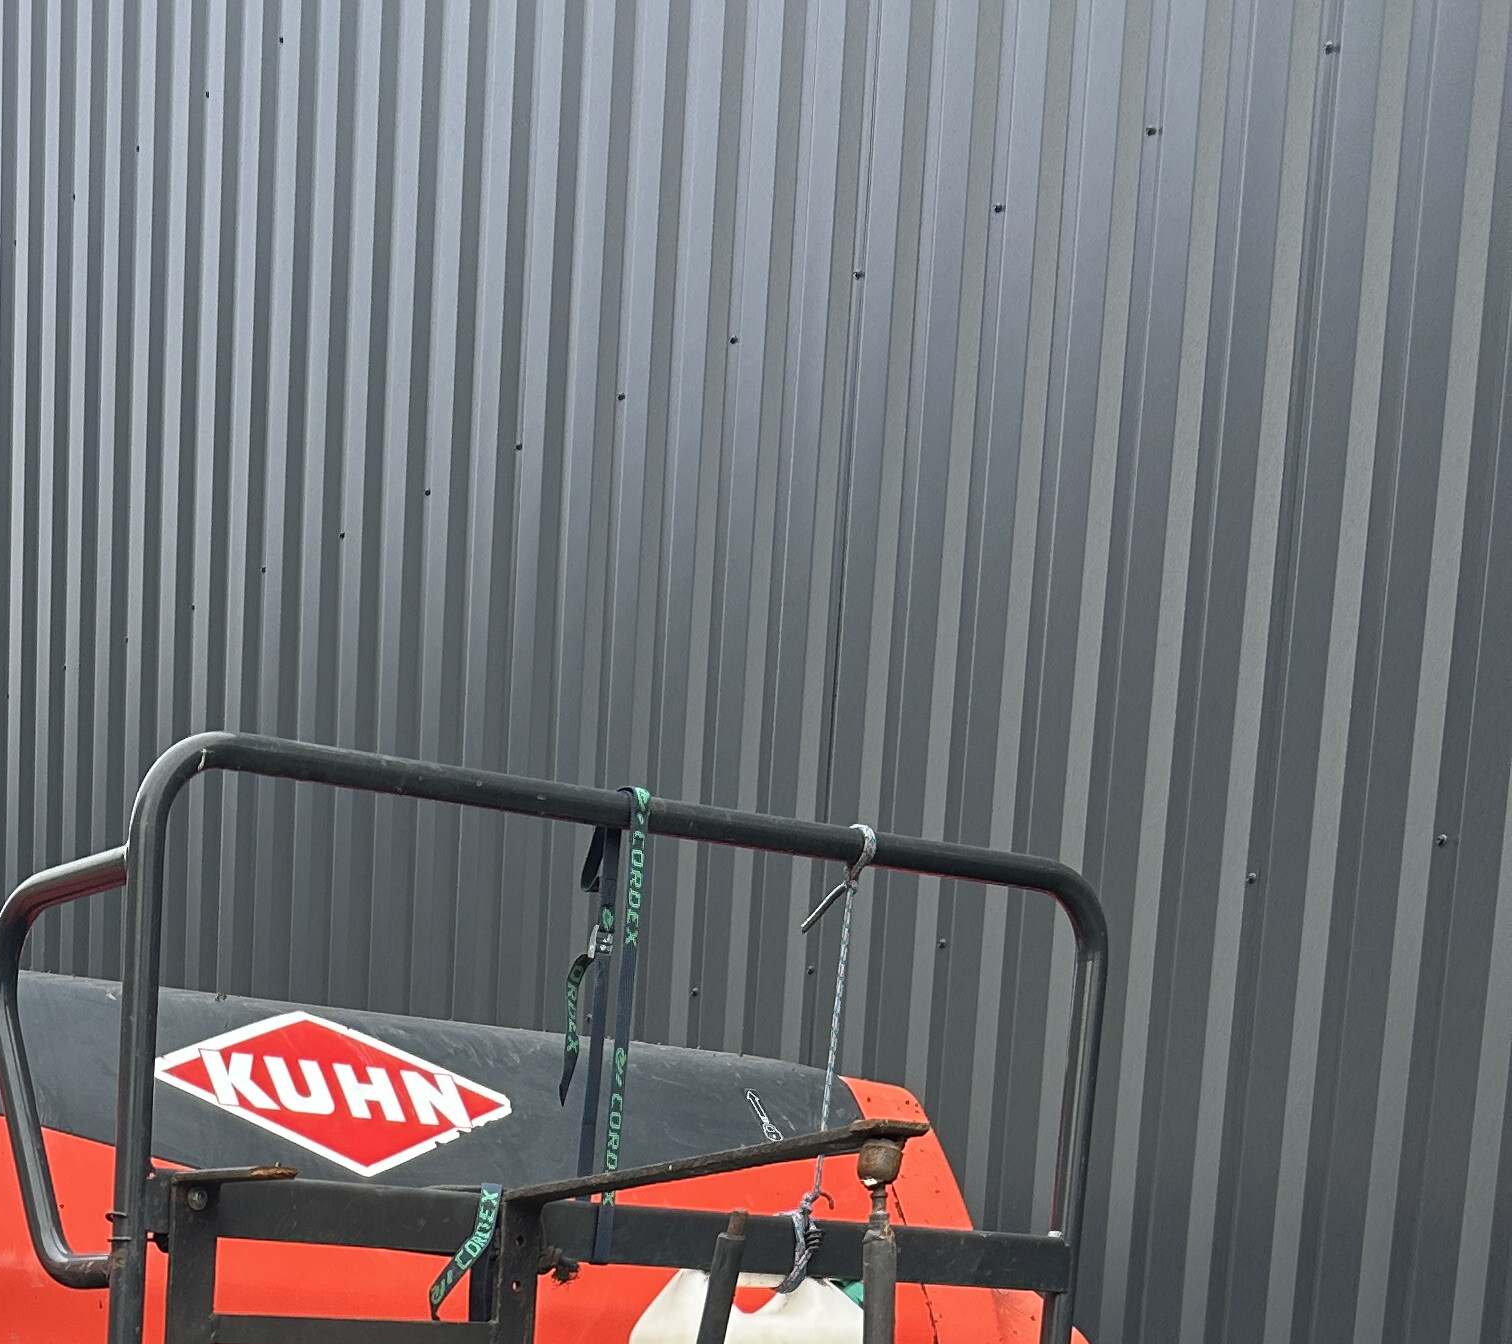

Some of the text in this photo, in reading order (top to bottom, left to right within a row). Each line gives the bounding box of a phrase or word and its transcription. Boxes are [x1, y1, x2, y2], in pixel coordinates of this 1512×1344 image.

[624, 830, 646, 947] CORDEX
[566, 964, 585, 1053] ORDEX
[198, 1048, 474, 1129] KUHN
[602, 1093, 623, 1206] CORDX
